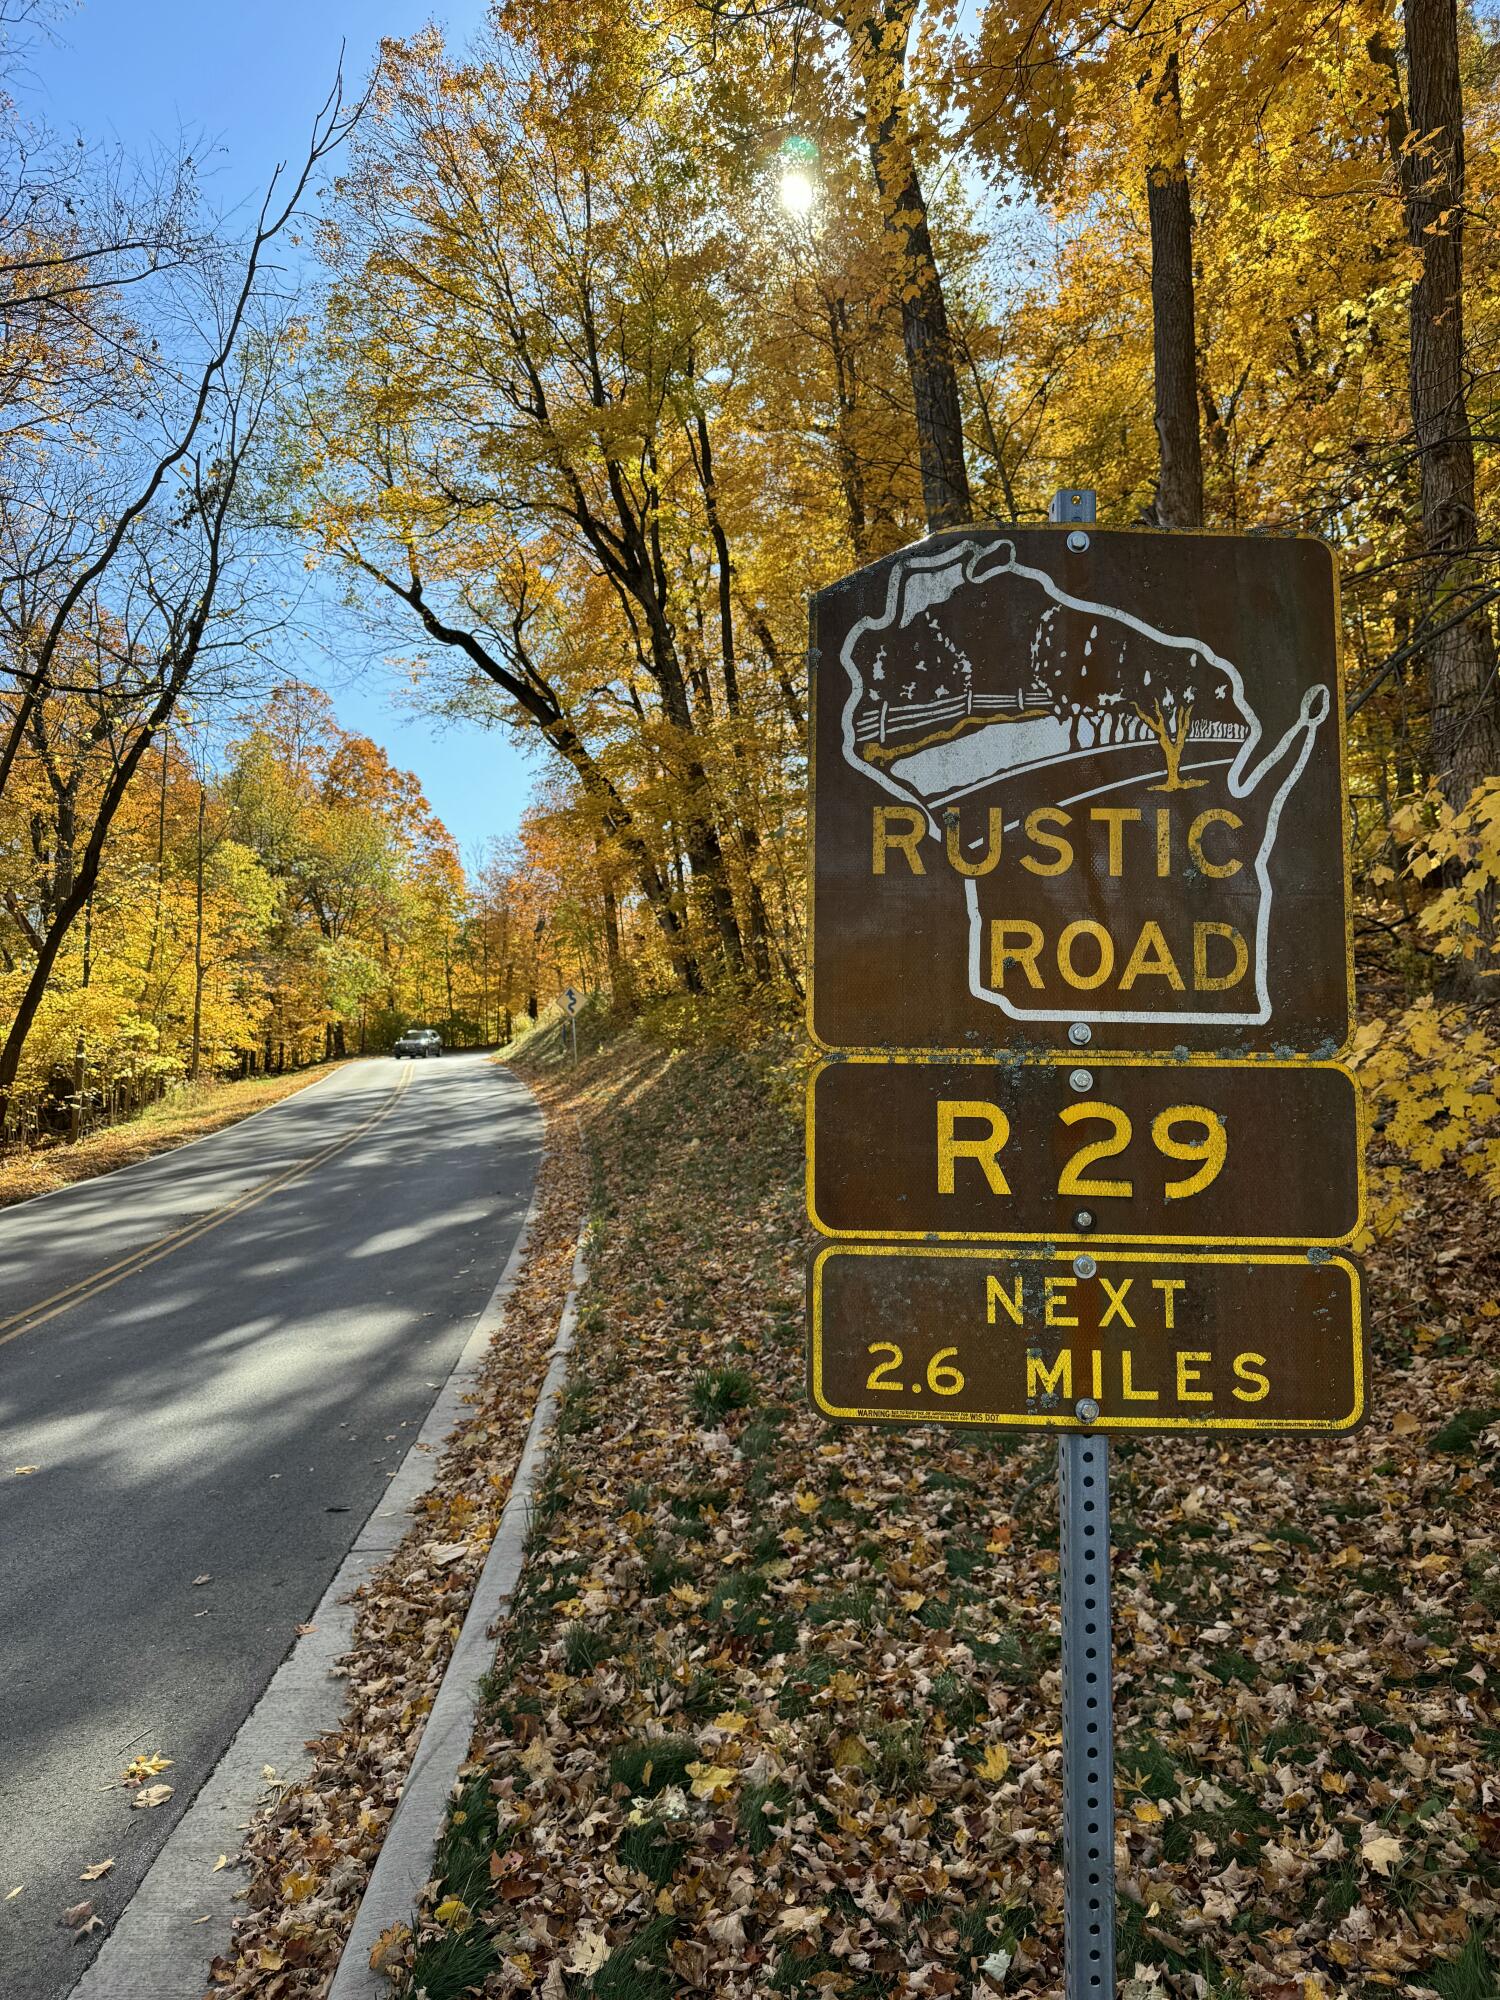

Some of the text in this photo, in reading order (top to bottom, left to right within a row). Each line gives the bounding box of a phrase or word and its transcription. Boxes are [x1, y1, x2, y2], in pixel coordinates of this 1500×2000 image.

[873, 806, 1242, 878] RUSTIC
[990, 919, 1248, 991] ROAD
[937, 1101, 1228, 1199] R 29
[986, 1275, 1186, 1328] NEXT
[866, 1341, 1271, 1402] 2.6 MILES
